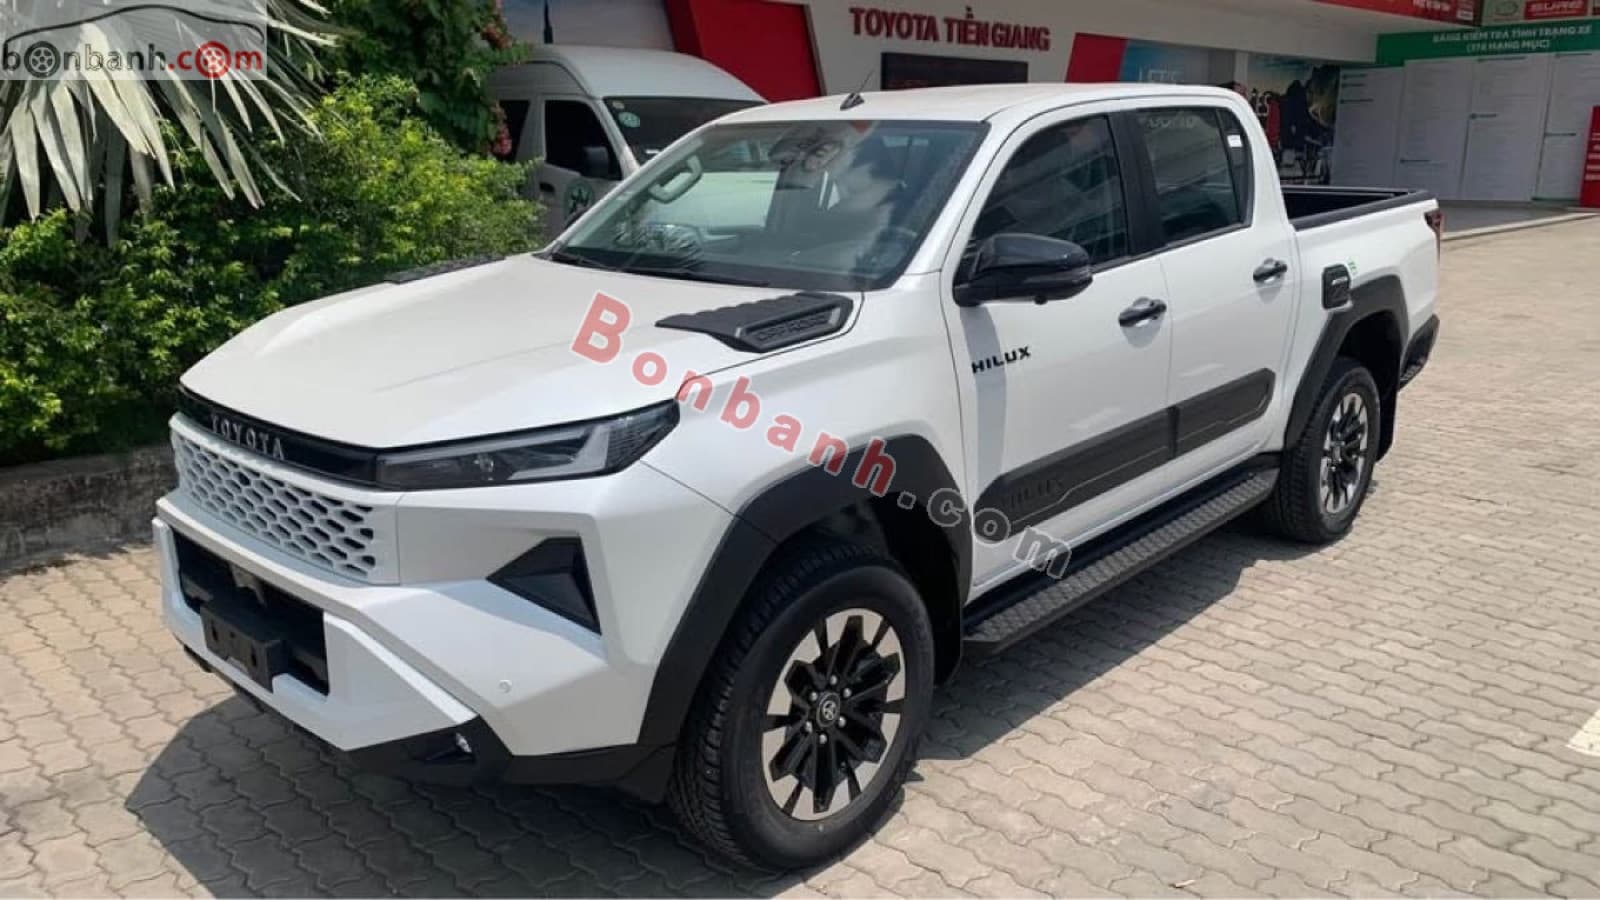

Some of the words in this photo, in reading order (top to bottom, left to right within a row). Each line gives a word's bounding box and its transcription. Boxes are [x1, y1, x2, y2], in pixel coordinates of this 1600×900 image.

[849, 7, 939, 42] TOYOTA
[943, 6, 989, 46] TIỀN
[991, 22, 1050, 51] GIANG
[971, 346, 1031, 374] HILUX
[210, 412, 285, 461] TOYOTA
